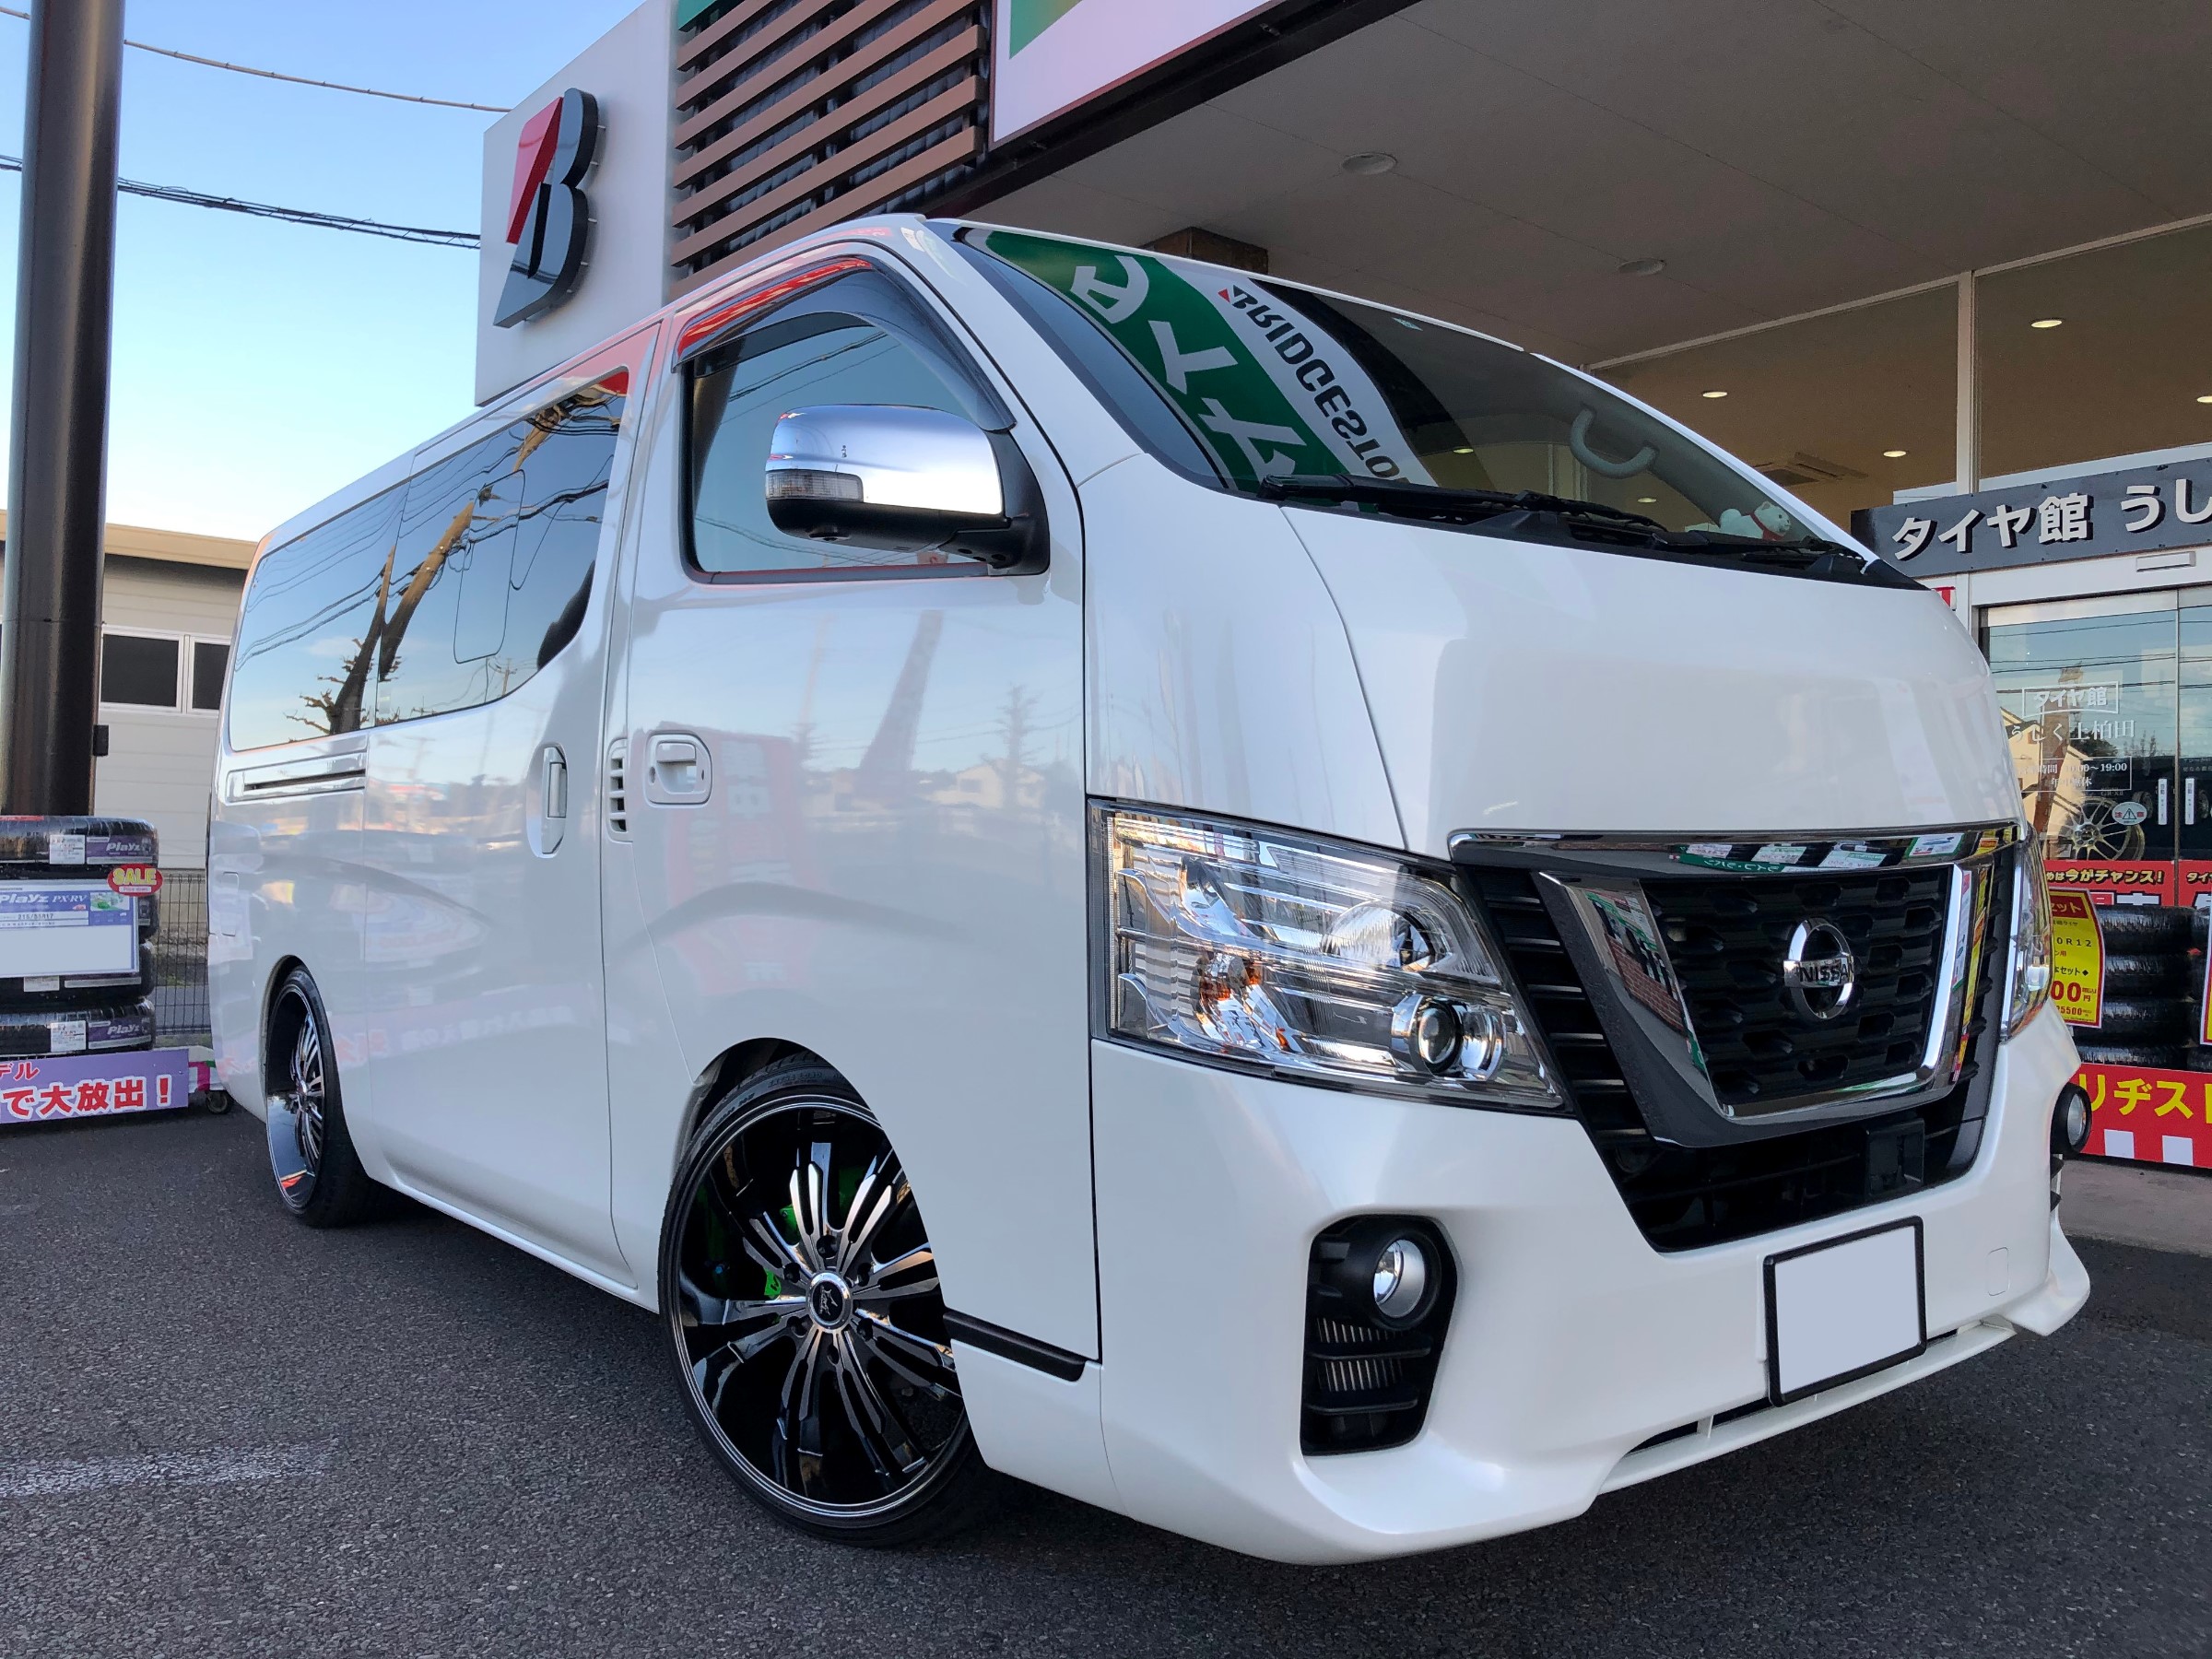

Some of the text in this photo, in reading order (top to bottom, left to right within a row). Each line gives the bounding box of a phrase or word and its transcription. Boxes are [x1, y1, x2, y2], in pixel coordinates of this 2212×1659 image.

[1892, 492, 2092, 561] タイヤ館
[2033, 687, 2107, 709] タイヤ館
[106, 841, 140, 852] Playz
[112, 868, 158, 886] SALE
[2, 1077, 171, 1117] で大放出!
